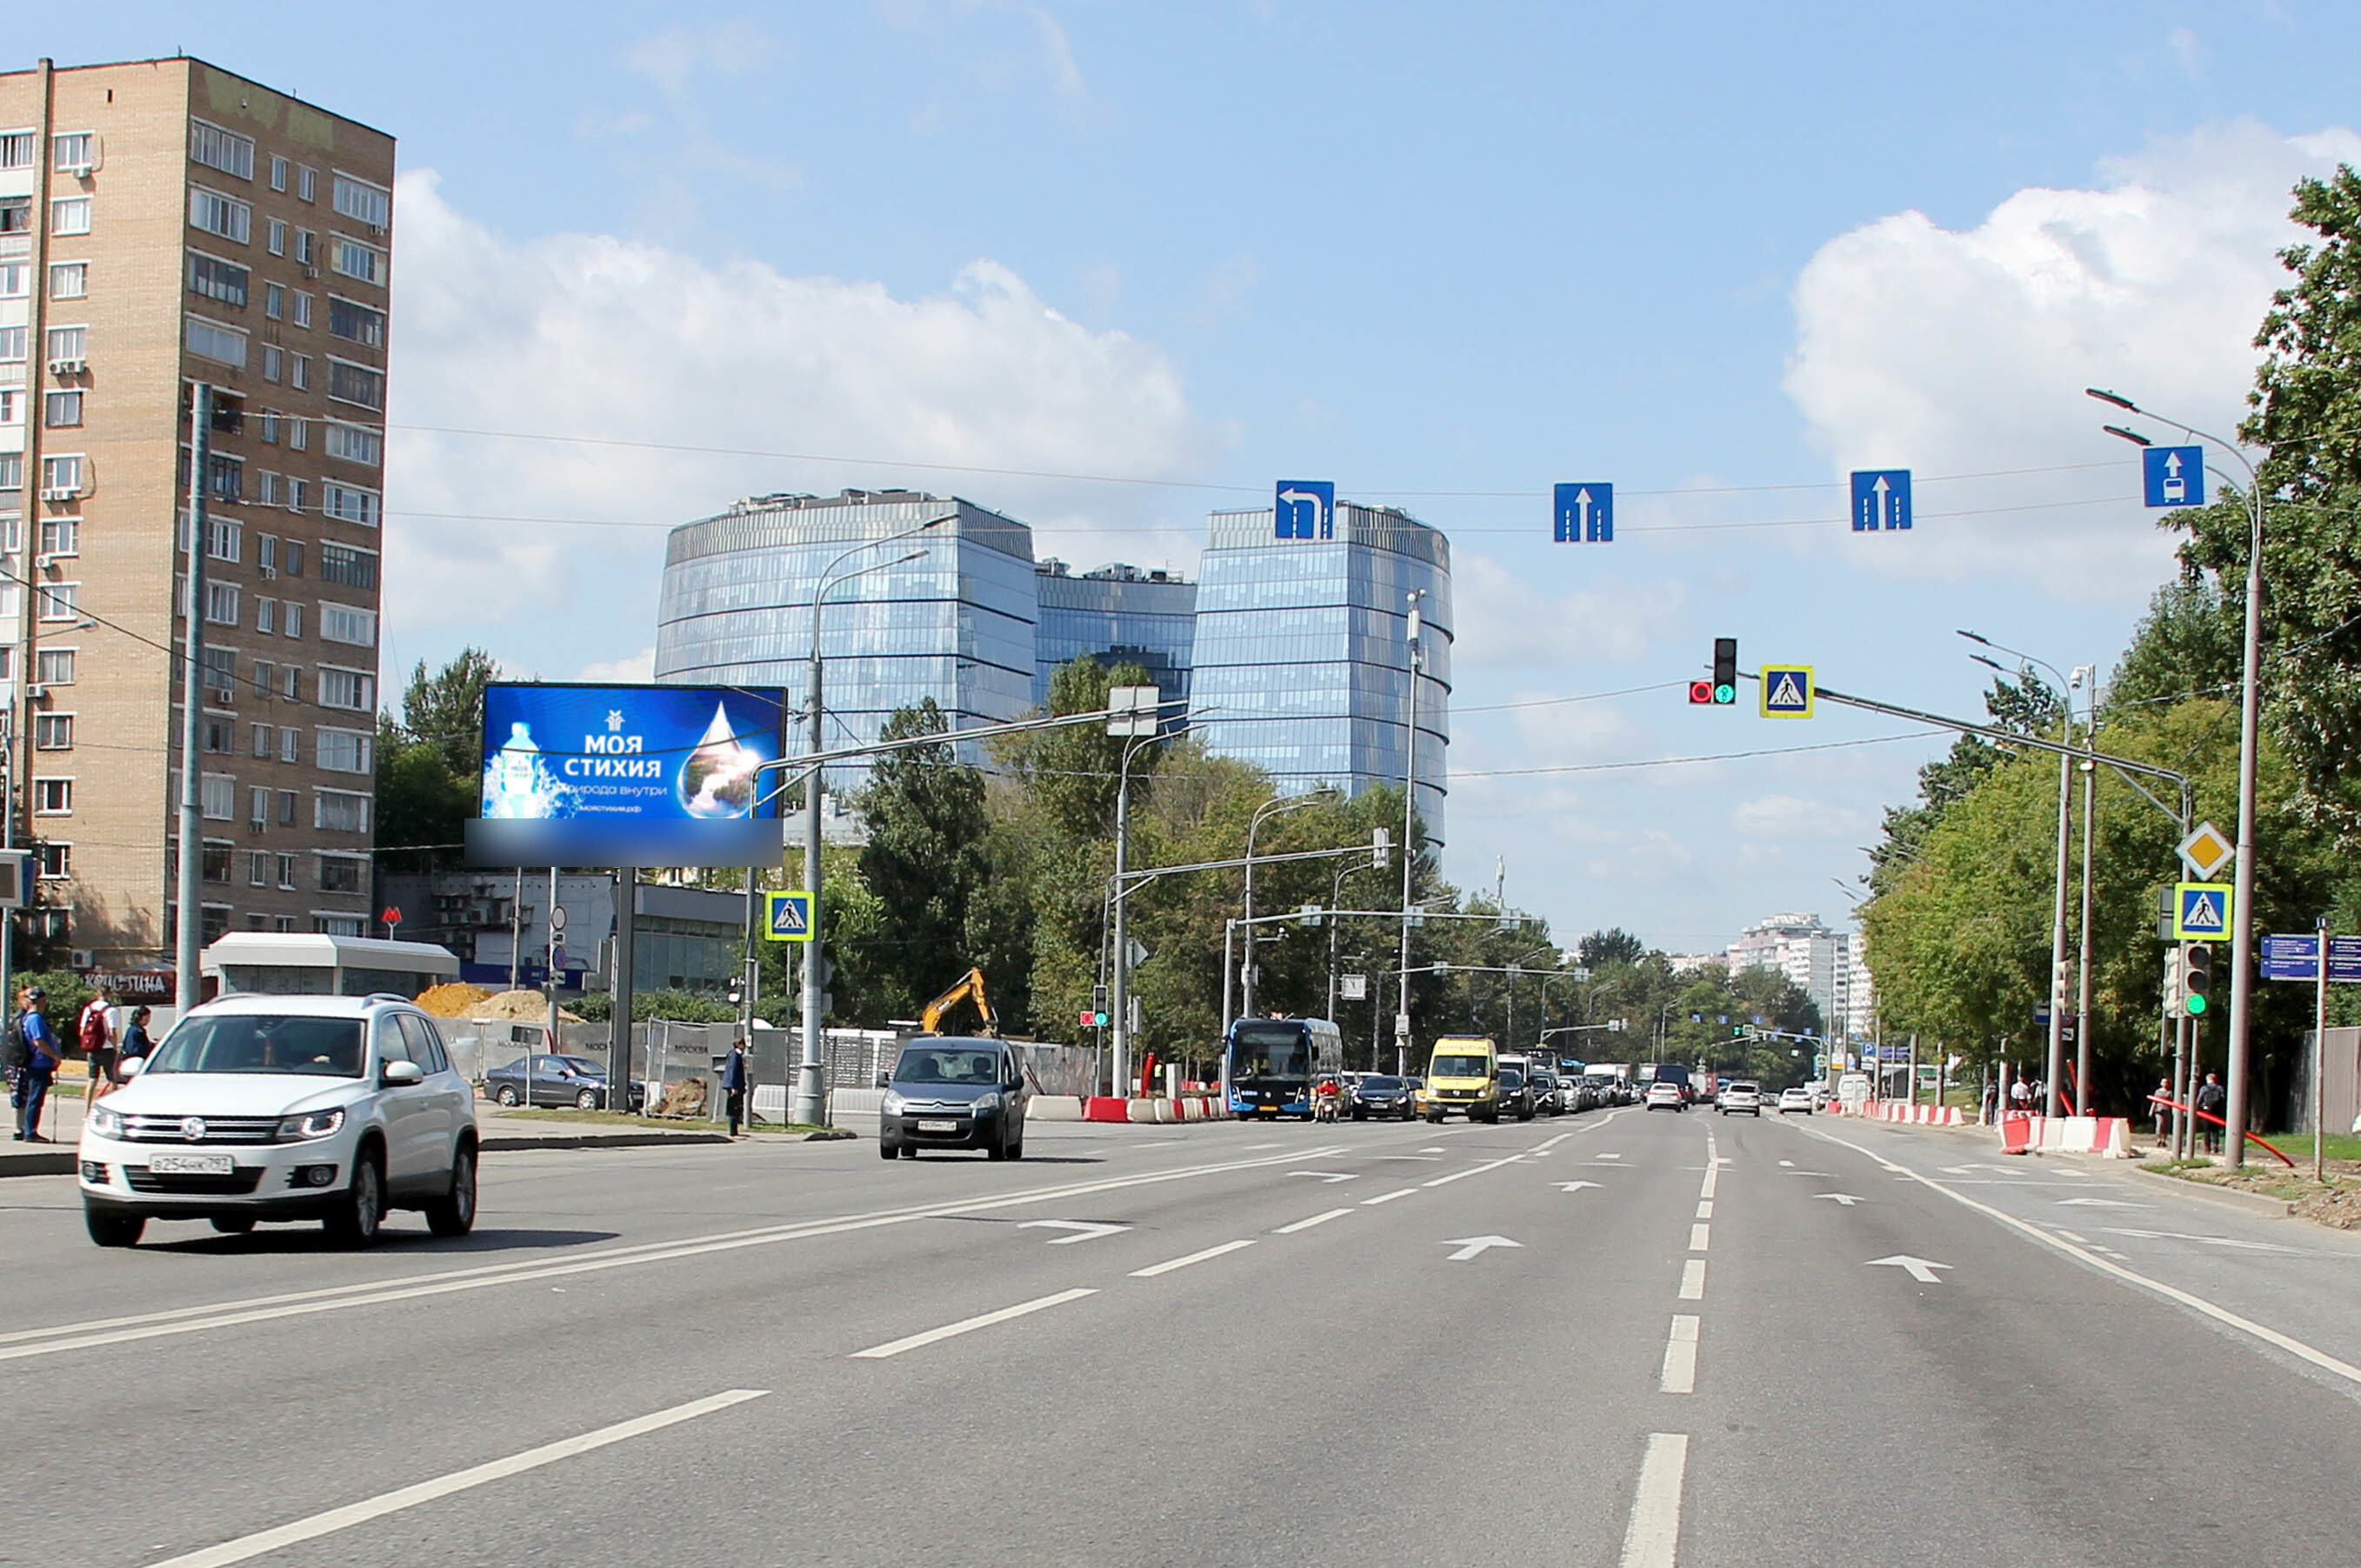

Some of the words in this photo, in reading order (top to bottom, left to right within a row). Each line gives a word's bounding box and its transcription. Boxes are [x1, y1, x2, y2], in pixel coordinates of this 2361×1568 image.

[584, 734, 643, 755] МОЯ
[564, 758, 661, 778] СТИХИЯ
[618, 785, 668, 797] внутри
